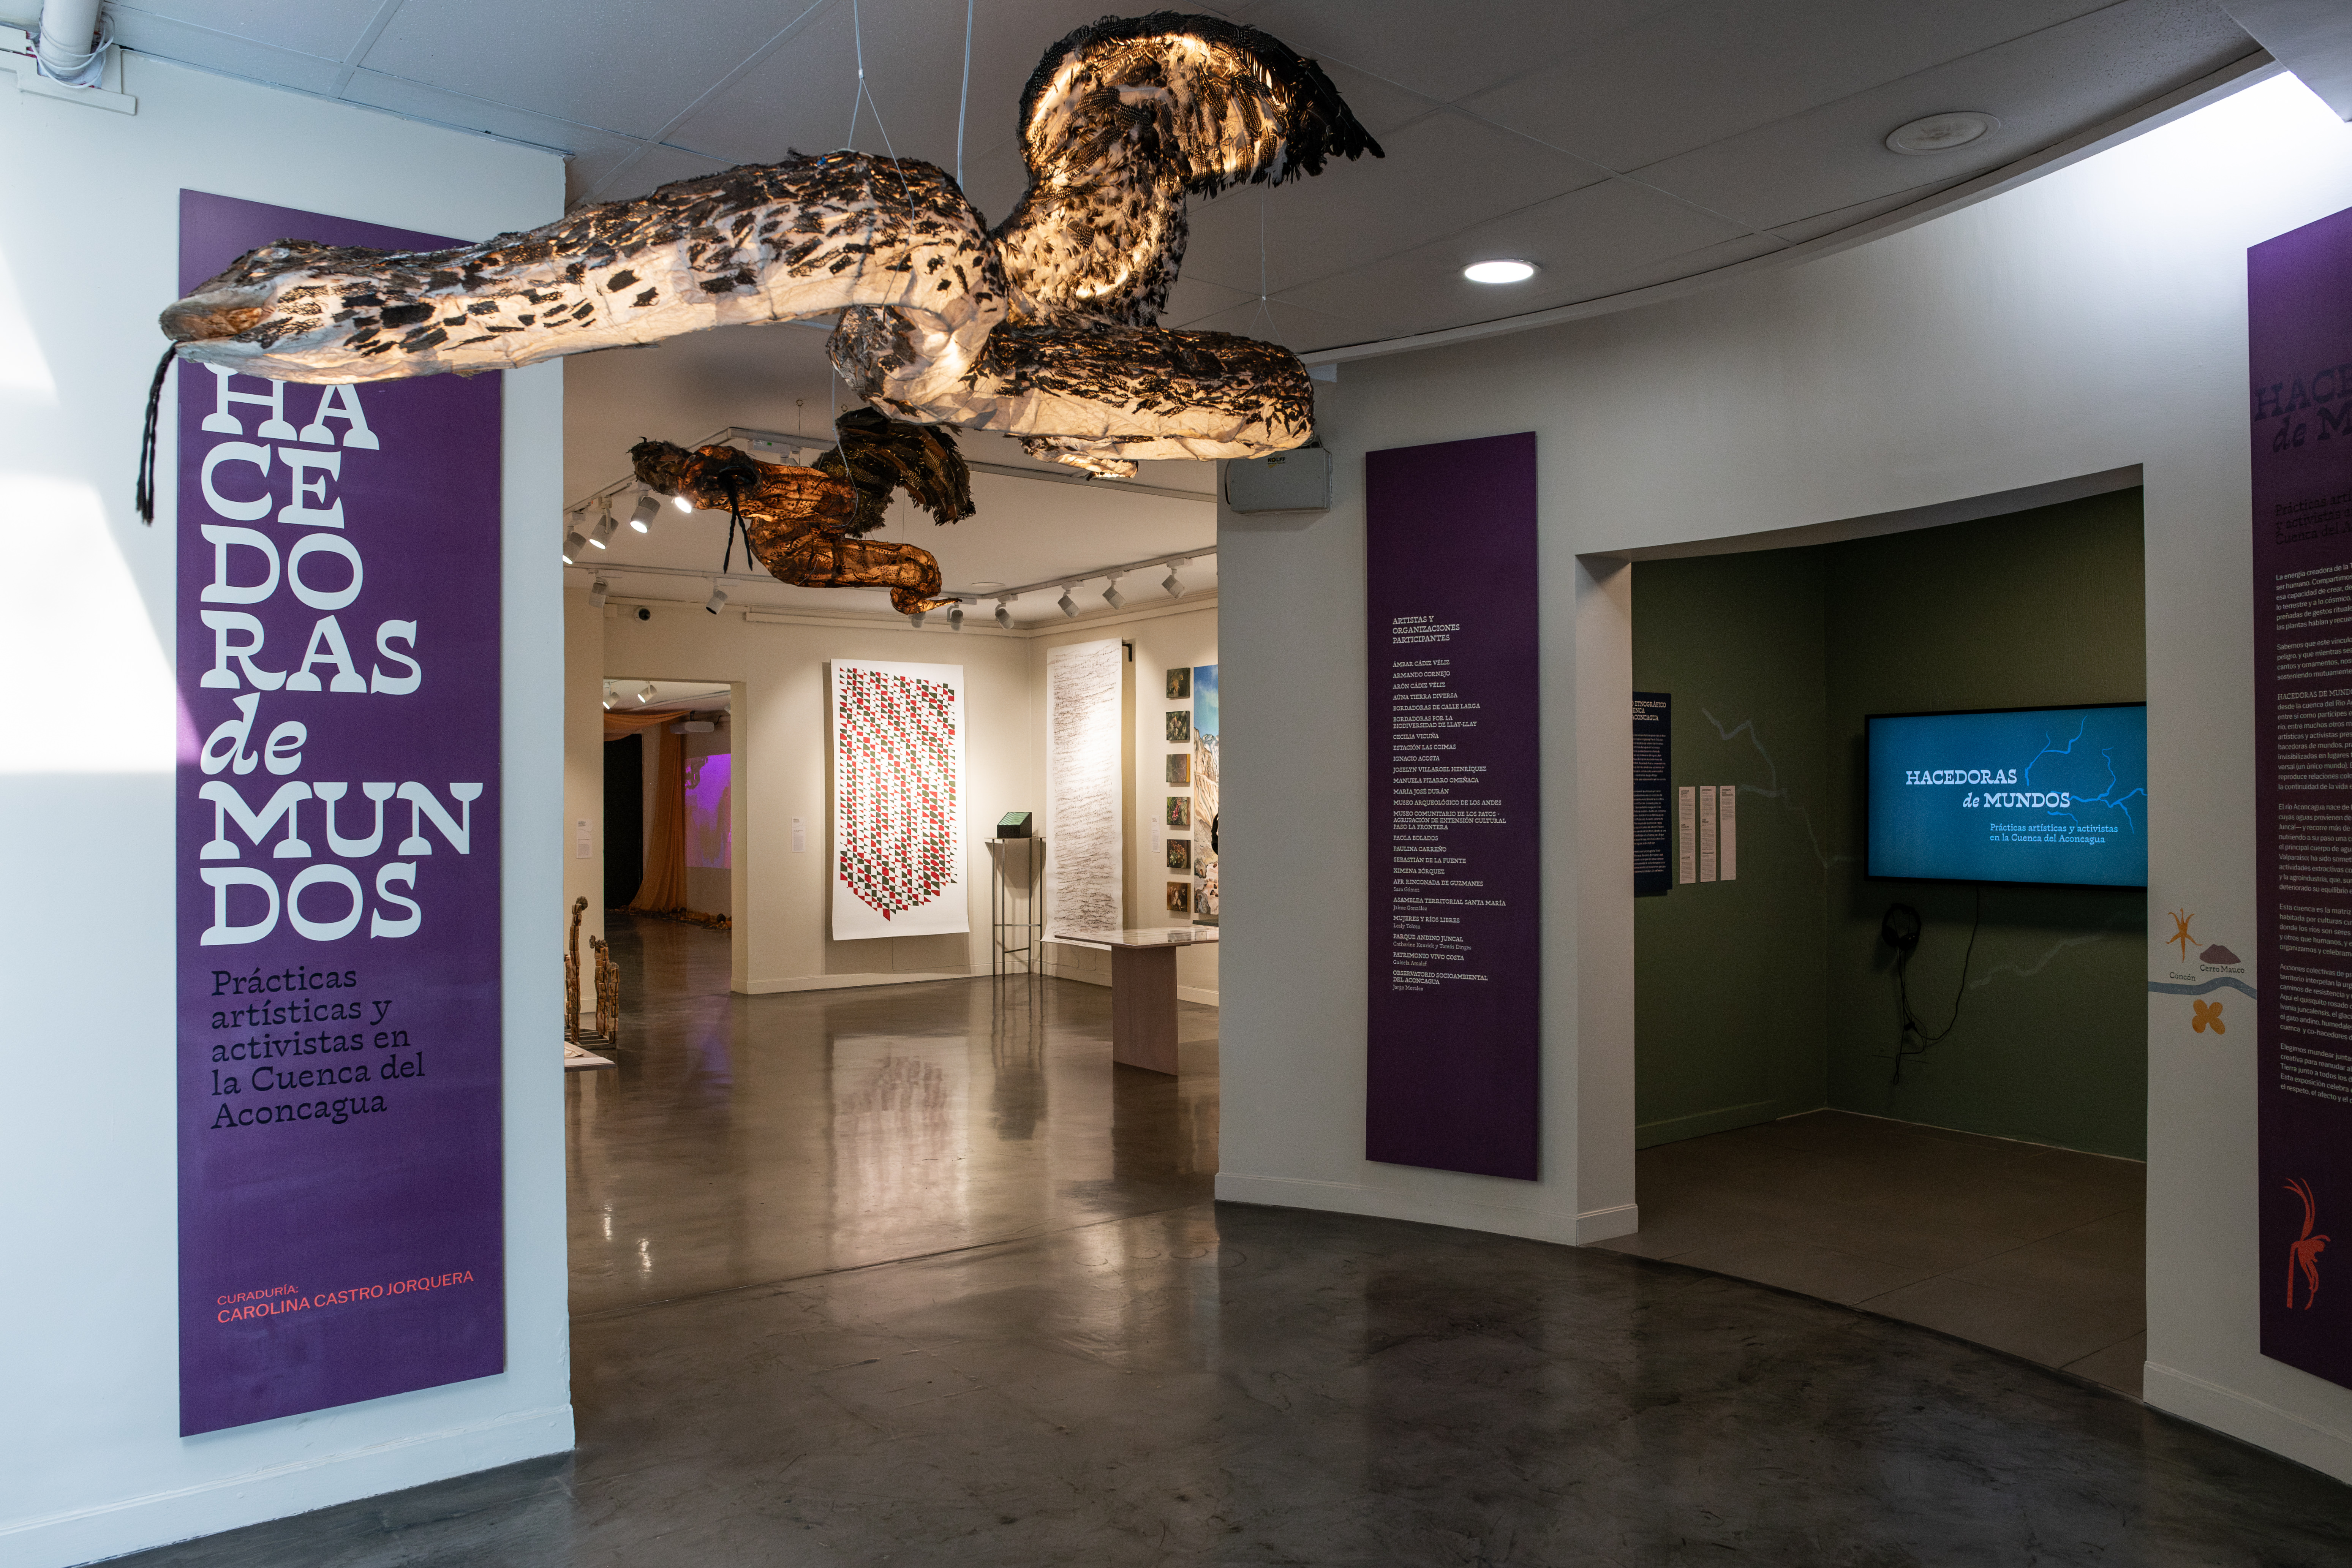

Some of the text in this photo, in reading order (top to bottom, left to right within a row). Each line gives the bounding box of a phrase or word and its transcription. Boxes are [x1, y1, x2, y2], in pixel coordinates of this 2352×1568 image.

[202, 362, 379, 450] HA
[2273, 416, 2306, 452] de
[201, 441, 345, 528] CE
[201, 524, 363, 610] DO
[2306, 567, 2332, 575] creadora
[1393, 616, 1427, 624] ARTISTAS
[1393, 624, 1459, 634] ORGANIZACIONES
[201, 610, 422, 695] RAS
[1393, 634, 1449, 643] PARTICIPANTES
[200, 692, 307, 775] de
[1906, 769, 2017, 784] HACEDORAS
[1963, 792, 2070, 807] de MUNDOS
[199, 781, 483, 860] MUN
[2058, 835, 2105, 844] Aconcagua
[201, 861, 421, 946] DOS
[212, 966, 356, 996] Prácticas
[2169, 972, 2195, 981] Concón
[212, 998, 392, 1029] artísticas y
[213, 1030, 411, 1062] activistas en
[213, 1052, 425, 1095] la Cuenca del
[211, 1095, 387, 1129] Aconcagua
[217, 1285, 299, 1305] CURADURÍA:
[217, 1271, 473, 1323] CAROLINA CASTRO JORQUERA
